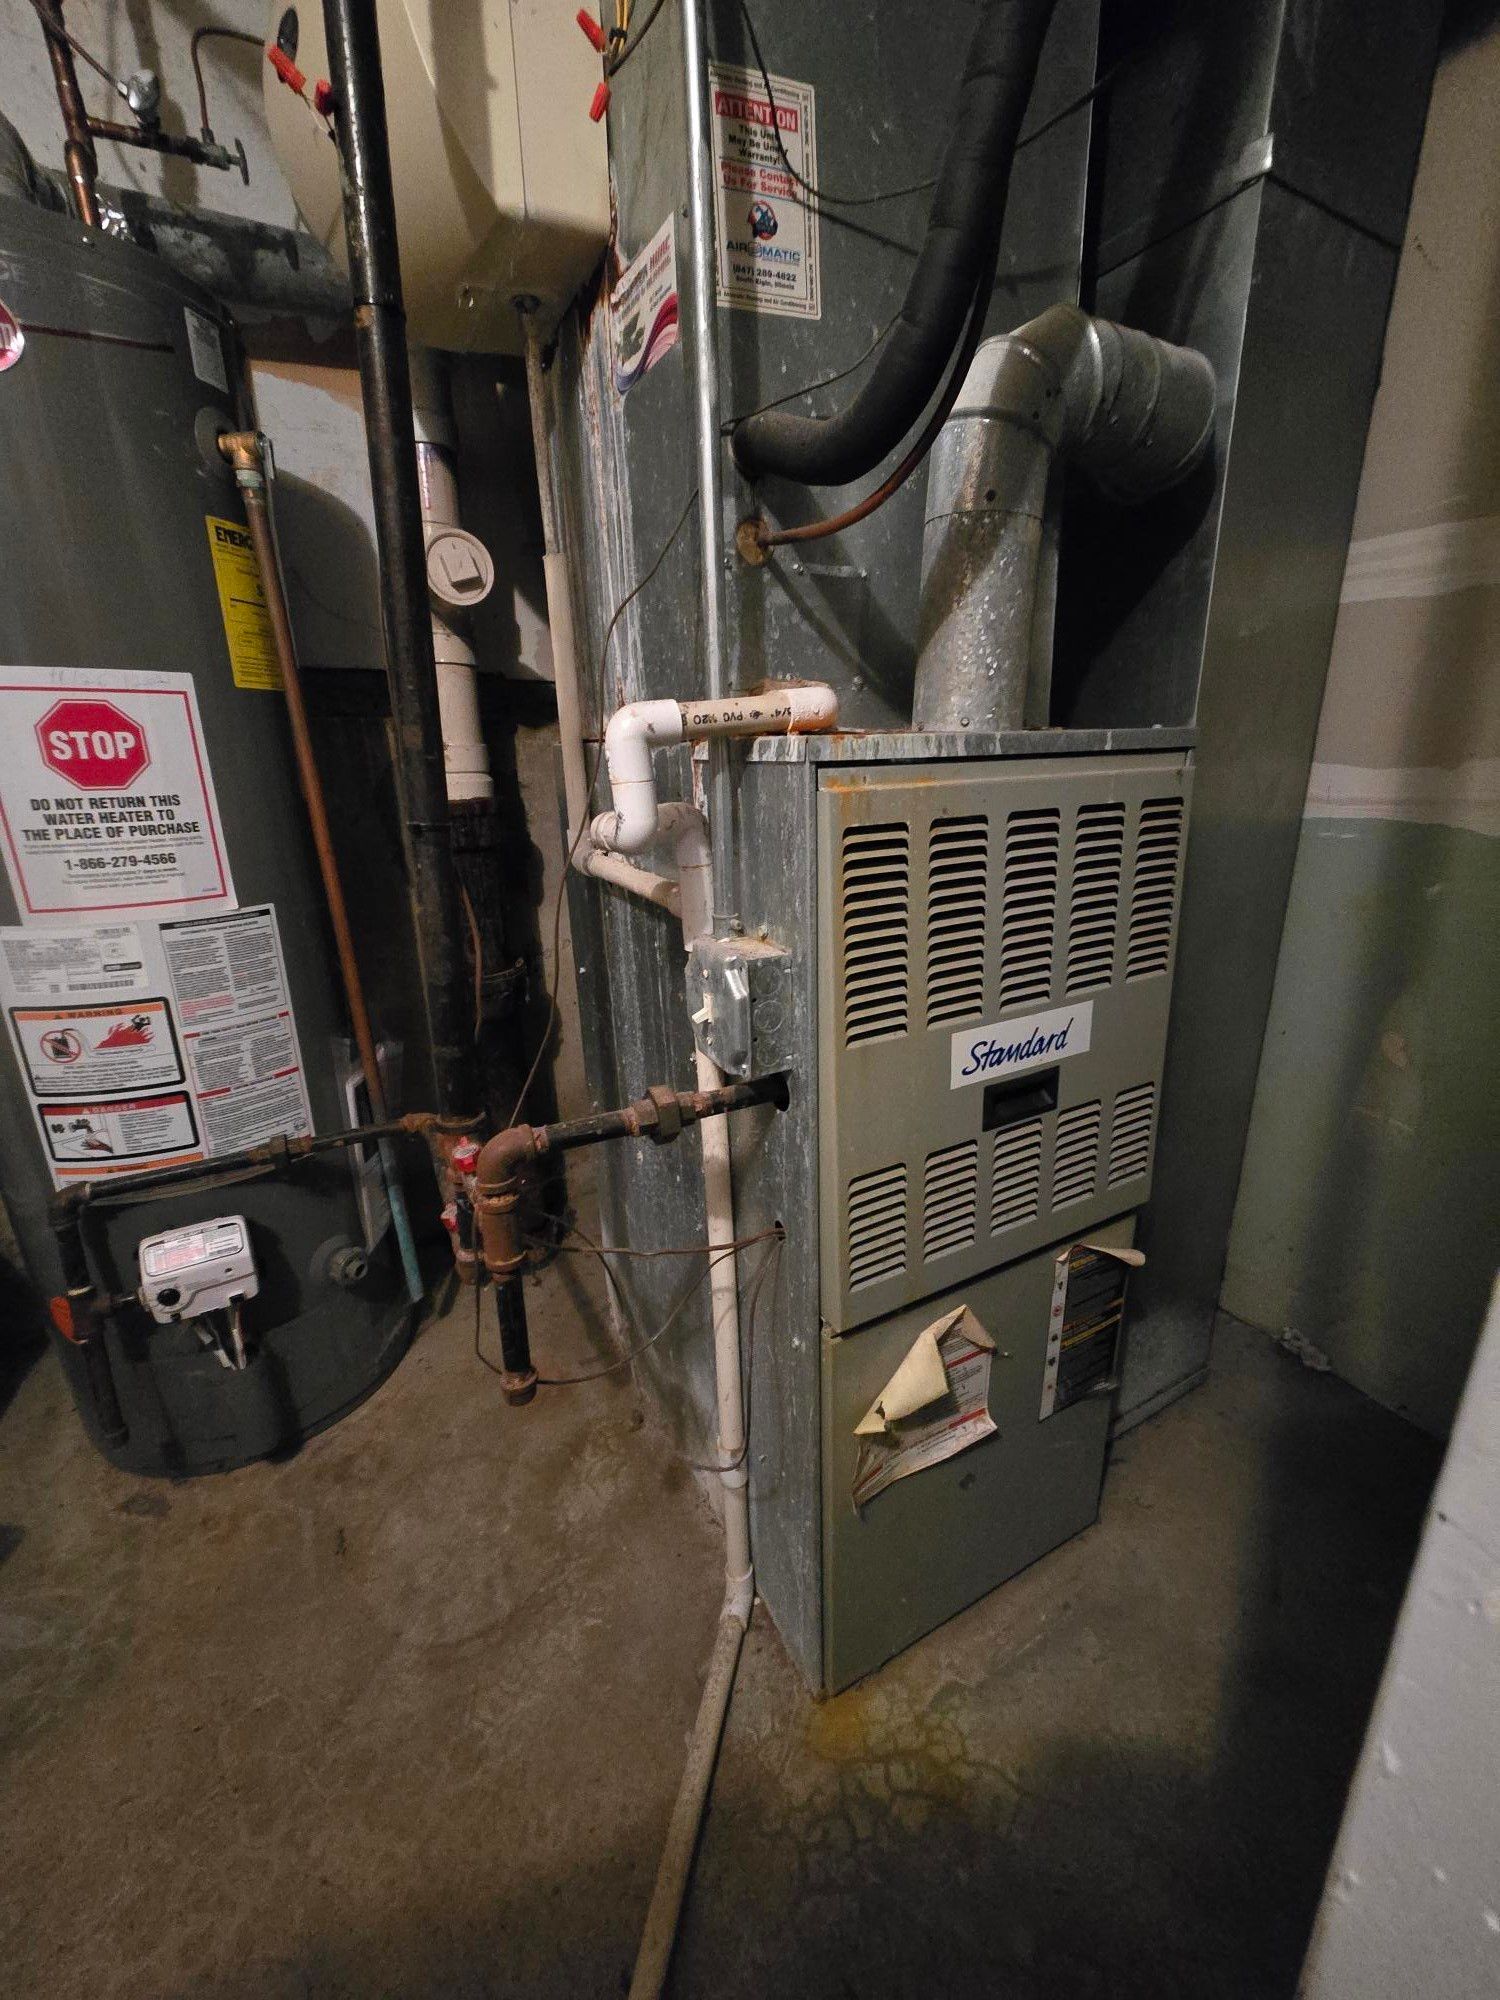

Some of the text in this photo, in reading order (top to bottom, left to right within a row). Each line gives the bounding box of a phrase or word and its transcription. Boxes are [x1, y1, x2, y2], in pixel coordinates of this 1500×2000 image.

[717, 93, 796, 131] ATTENTON
[739, 125, 758, 137] This
[728, 134, 747, 147] May
[749, 139, 760, 147] Be
[723, 711, 743, 722] PVC
[49, 730, 136, 760] STOP
[30, 794, 181, 811] DO NOT RETURN THIS
[43, 809, 175, 826] WATER HEATER TO
[22, 821, 201, 841] THE PLACE OF PURCHASE
[64, 852, 177, 871] 1-866-279-4566
[67, 1007, 122, 1019] WARNING
[961, 1016, 1075, 1076] Standard
[92, 1103, 136, 1113] DANGER
